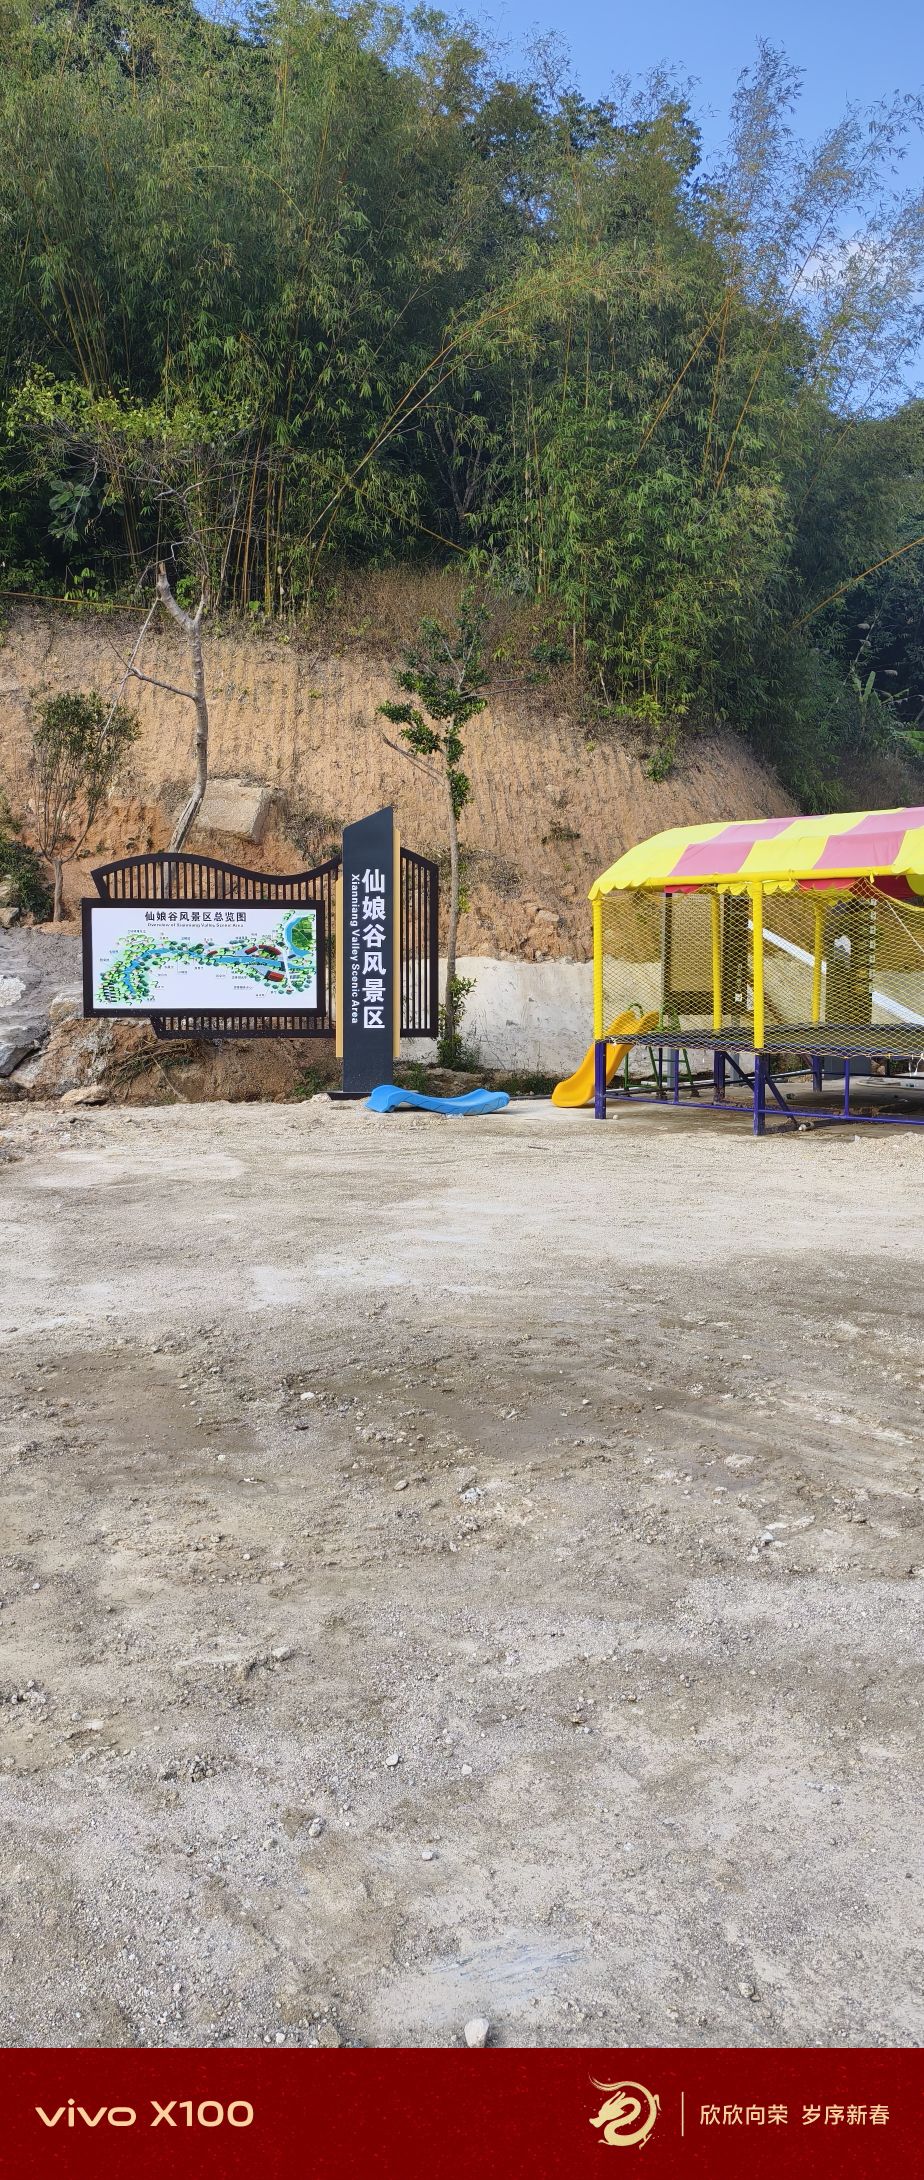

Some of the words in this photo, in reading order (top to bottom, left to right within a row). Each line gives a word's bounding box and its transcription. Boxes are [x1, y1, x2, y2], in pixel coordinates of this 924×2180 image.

[145, 911, 247, 922] 仙娘谷风景区总览图
[350, 873, 360, 927] Xianniang
[350, 929, 360, 962] Valley
[362, 868, 387, 1029] 仙娘谷风景区
[351, 963, 360, 997] Scenic
[351, 999, 360, 1024] Area
